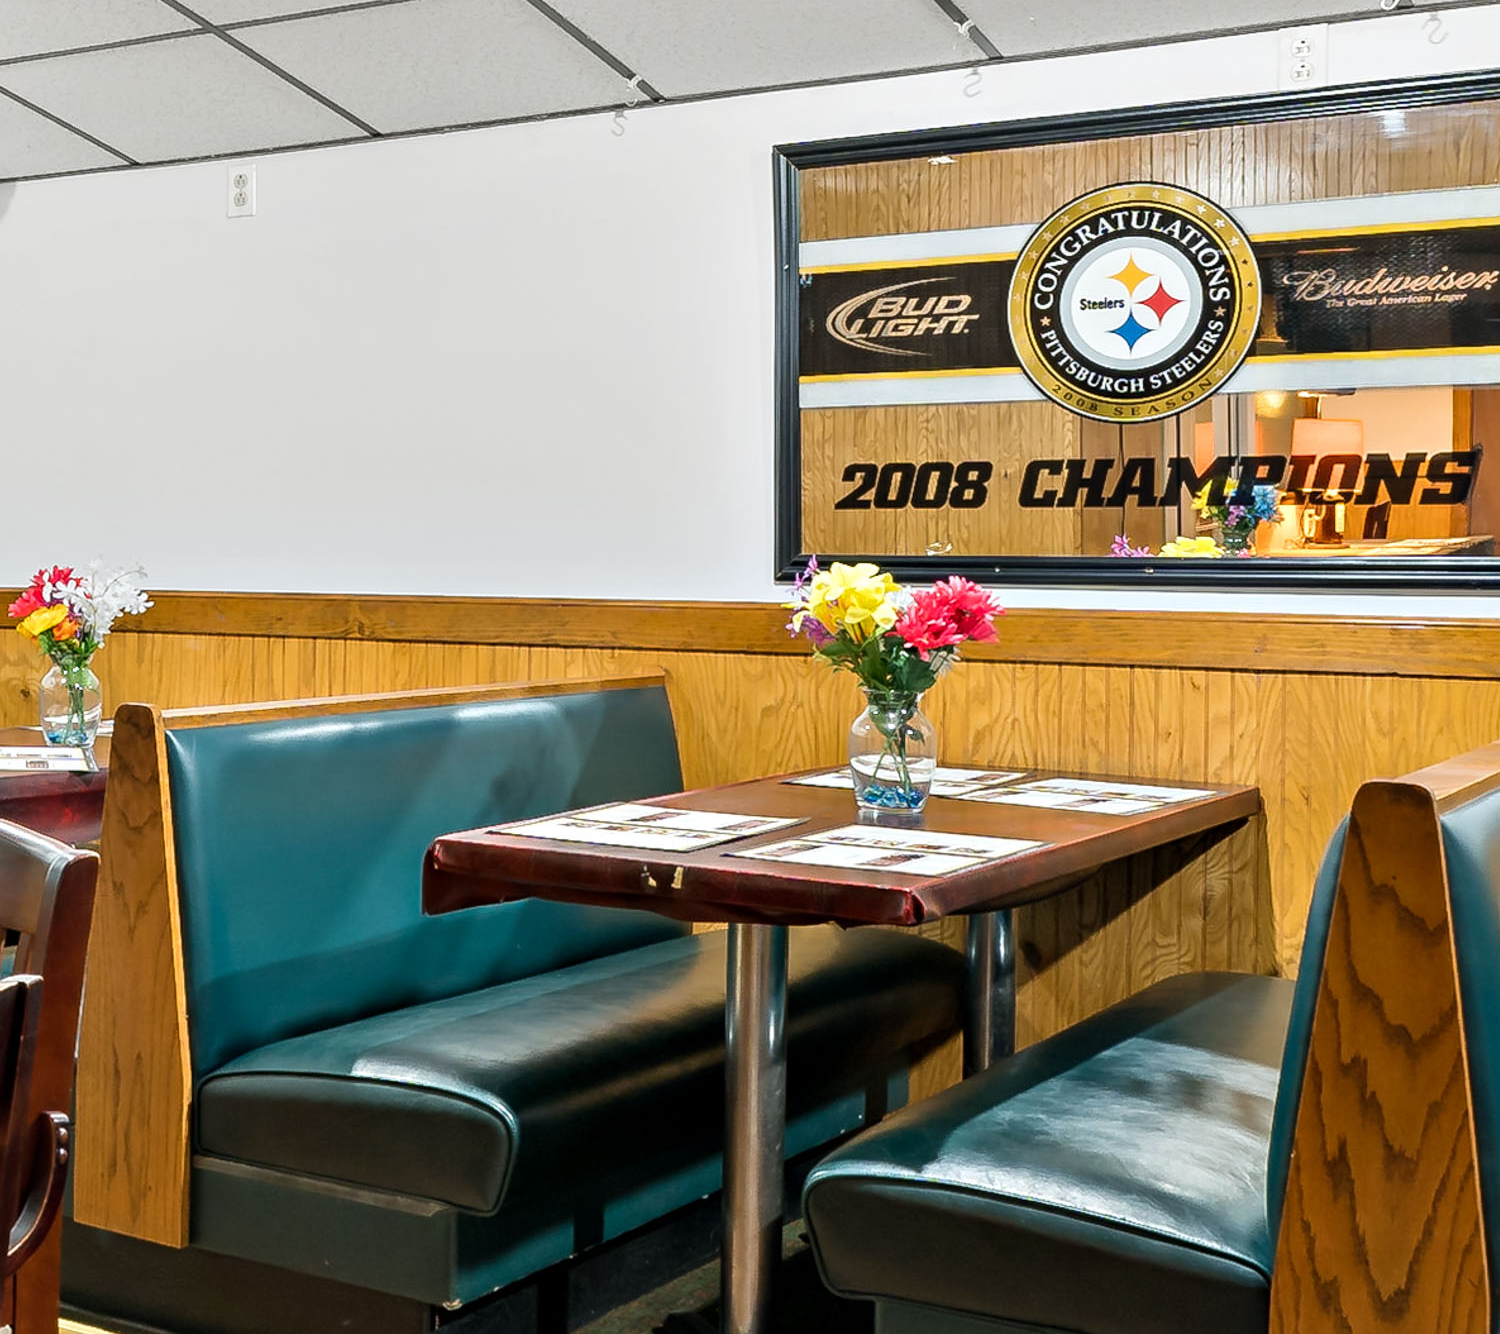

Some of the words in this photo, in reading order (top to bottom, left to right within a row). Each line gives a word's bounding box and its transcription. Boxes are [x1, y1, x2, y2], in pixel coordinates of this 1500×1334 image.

[1034, 210, 1231, 310] CONGRATULATIONS
[1282, 266, 1500, 302] Budweiser
[1379, 295, 1432, 305] American
[1434, 292, 1468, 304] Lager
[867, 294, 972, 319] BUD
[1080, 298, 1125, 311] Steelers
[845, 314, 980, 339] LIGHT
[1040, 329, 1144, 393] PITTSBURGH
[1149, 319, 1224, 389] STEELERS
[1051, 384, 1099, 412] 2008
[1113, 379, 1213, 416] SEASON
[833, 460, 992, 510] 2008
[1018, 452, 1481, 508] CHAMPIONS
